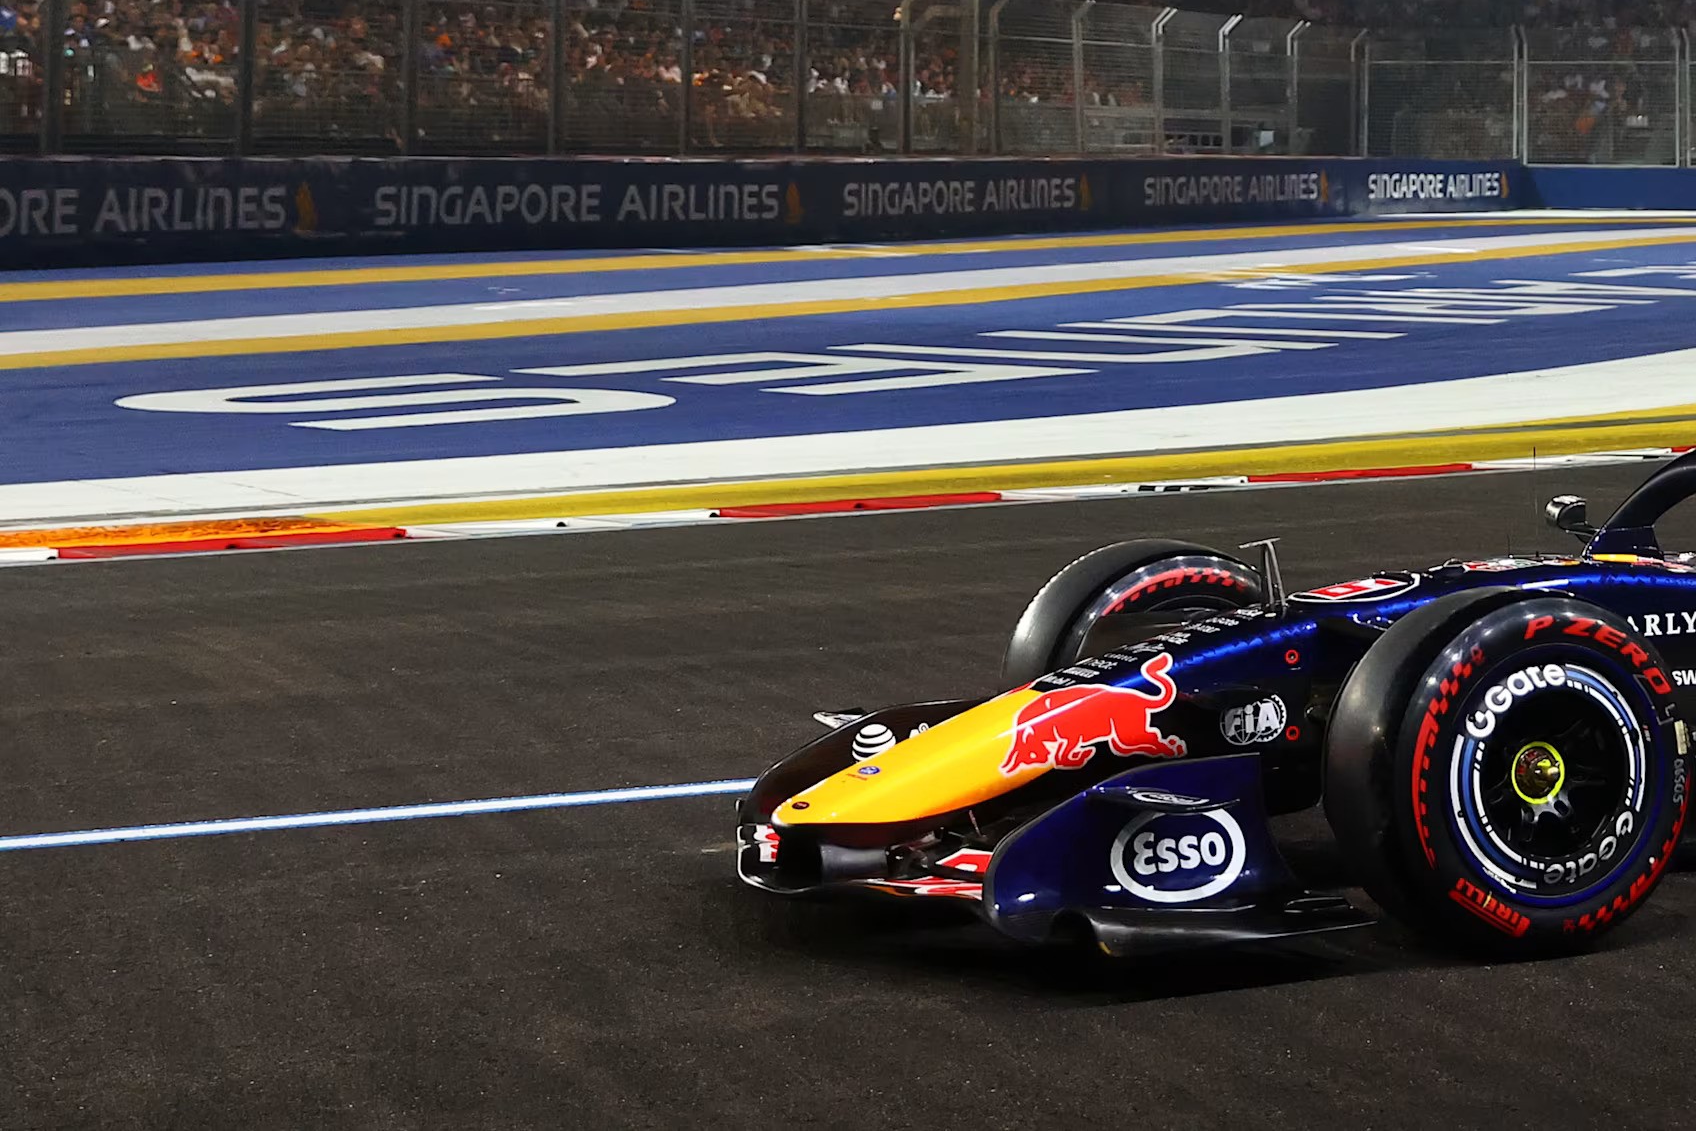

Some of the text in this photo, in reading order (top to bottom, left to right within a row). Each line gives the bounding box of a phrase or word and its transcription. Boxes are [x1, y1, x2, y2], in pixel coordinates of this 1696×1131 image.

[374, 183, 779, 225] SINGAPORE AIRLINES
[844, 177, 1075, 217] SINGAPORE AIRLINES
[1144, 173, 1318, 207] SINGAPORE AIRLINES
[1368, 173, 1500, 199] SINGAPORE AIRLINES
[95, 186, 286, 233] AIRLINES
[1133, 831, 1226, 876] Esso
